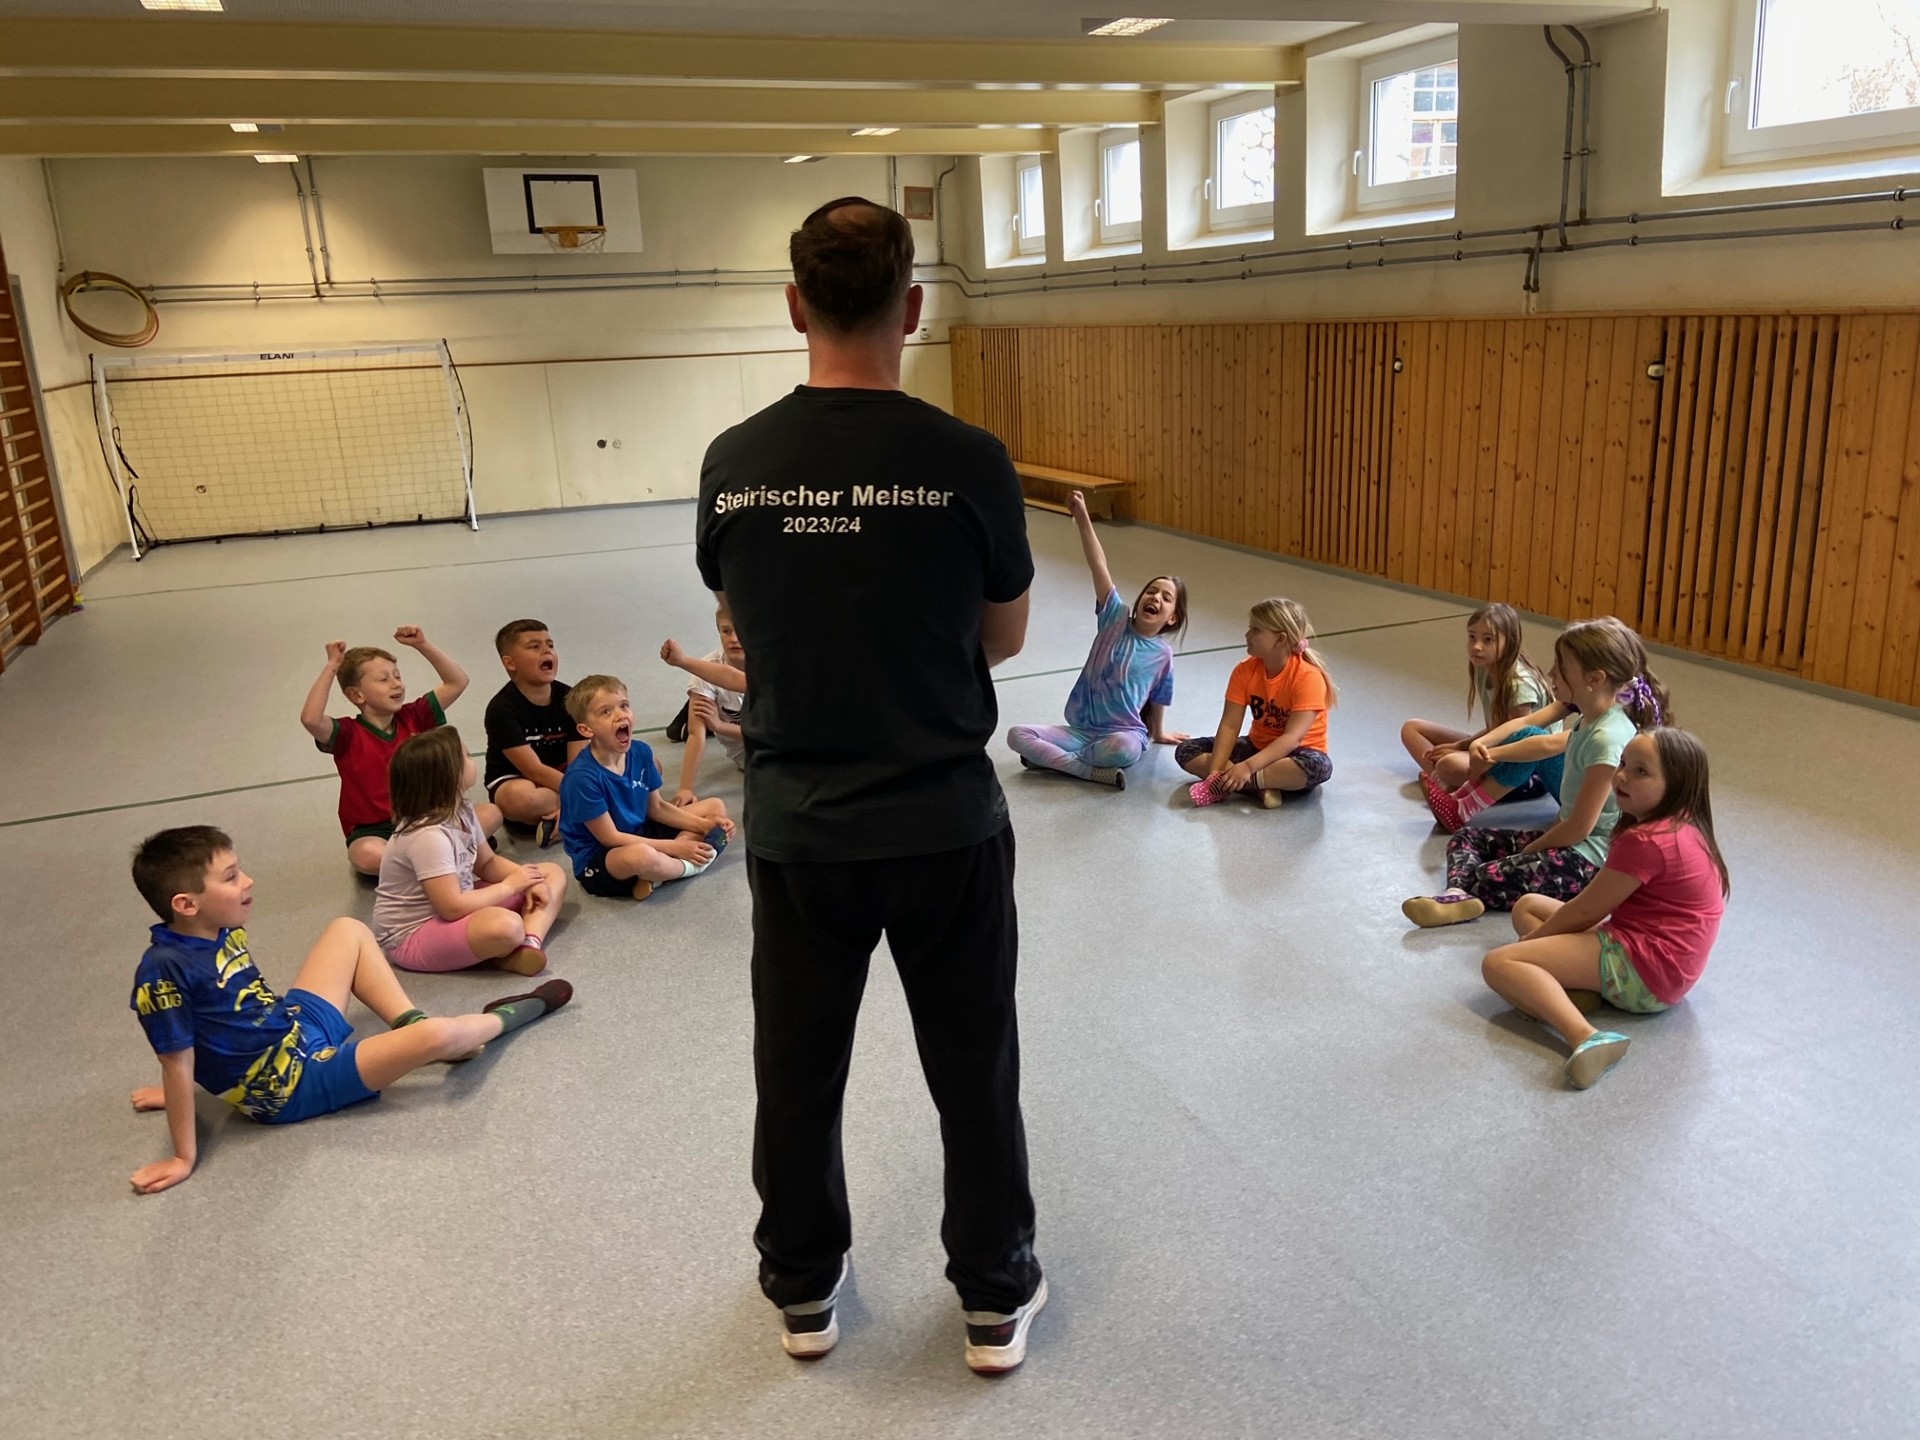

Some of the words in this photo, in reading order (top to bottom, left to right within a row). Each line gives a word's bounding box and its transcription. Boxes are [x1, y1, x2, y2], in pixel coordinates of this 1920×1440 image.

[714, 485, 844, 514] Steirischer
[852, 485, 953, 507] Meister
[783, 516, 862, 533] 2023/24
